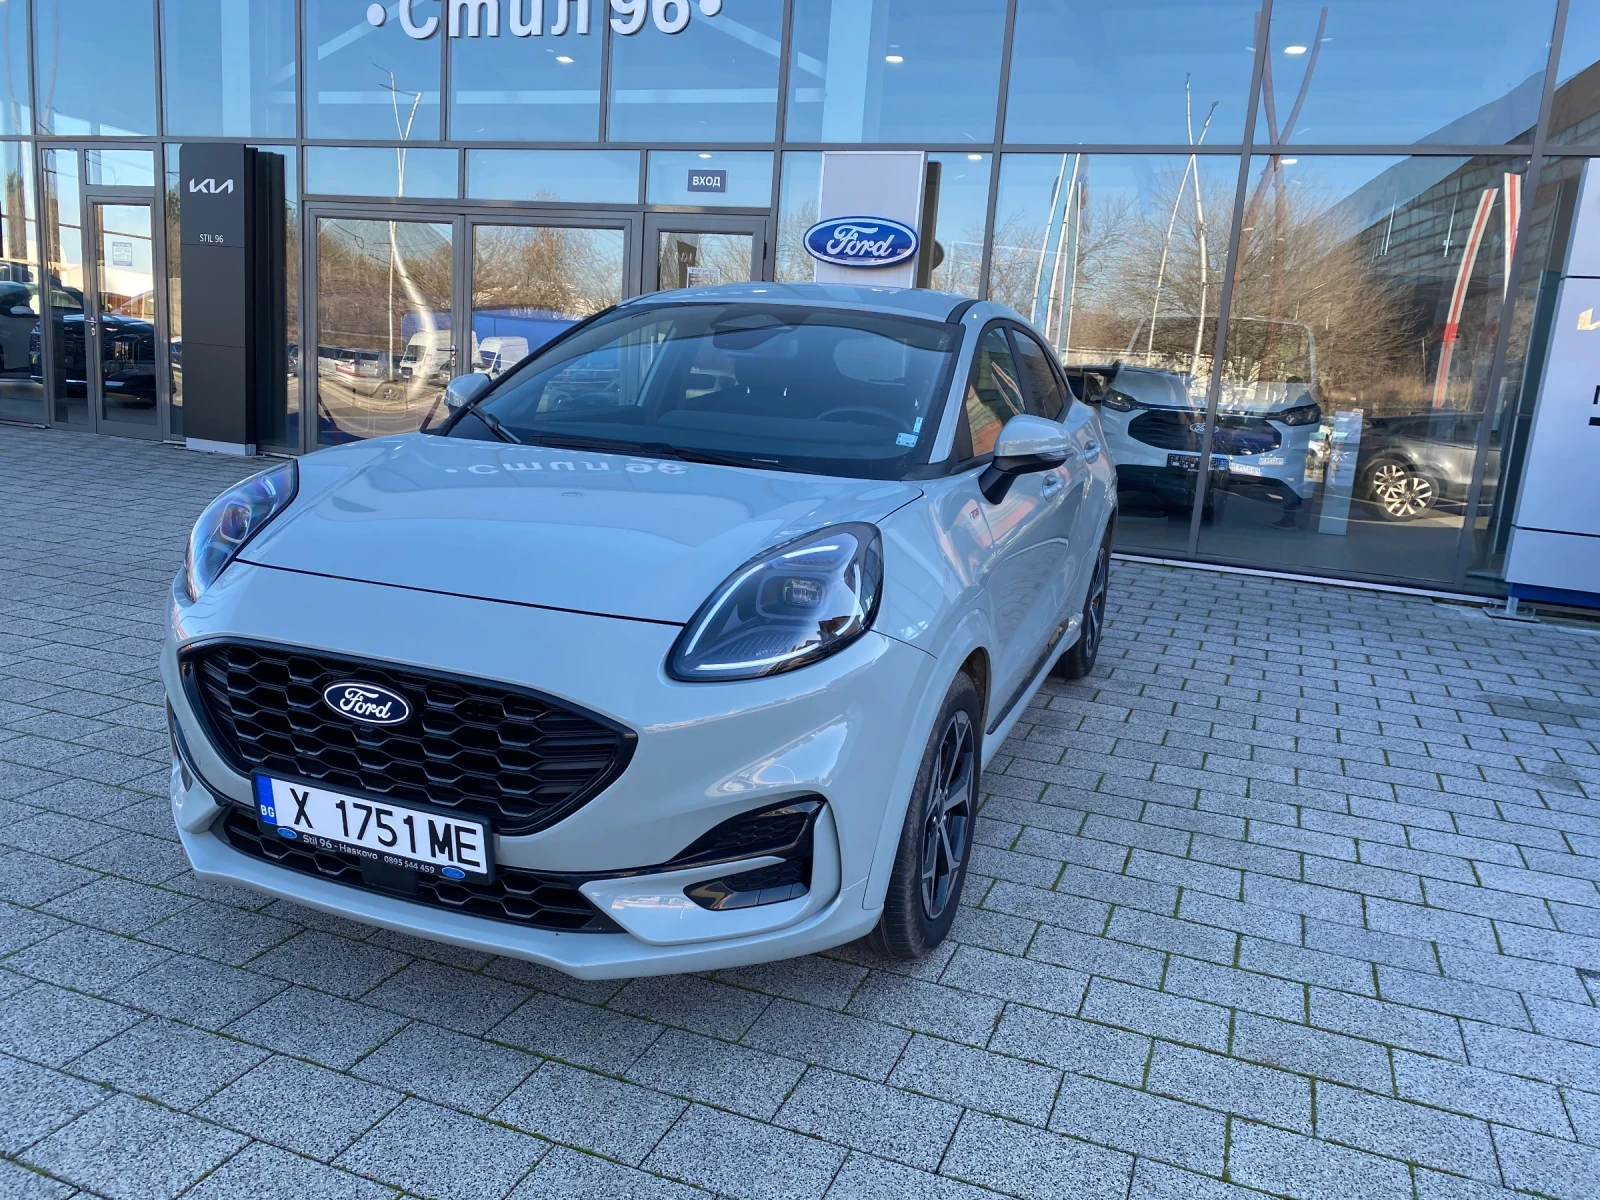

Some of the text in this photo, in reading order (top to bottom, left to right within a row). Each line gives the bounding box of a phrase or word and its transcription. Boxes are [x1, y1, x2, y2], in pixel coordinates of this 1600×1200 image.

[189, 178, 234, 194] KIA
[692, 176, 721, 188] ВХОД
[199, 233, 224, 244] STIL 96
[826, 224, 896, 257] Ford
[339, 688, 393, 719] Ford
[260, 804, 276, 818] BG
[289, 788, 314, 829] X
[335, 799, 417, 854] 1751
[302, 834, 318, 846] Stil
[319, 838, 333, 849] 96
[339, 843, 379, 860] Haskovo
[383, 856, 403, 867] 0895
[404, 859, 419, 871] 544
[420, 863, 435, 874] 459
